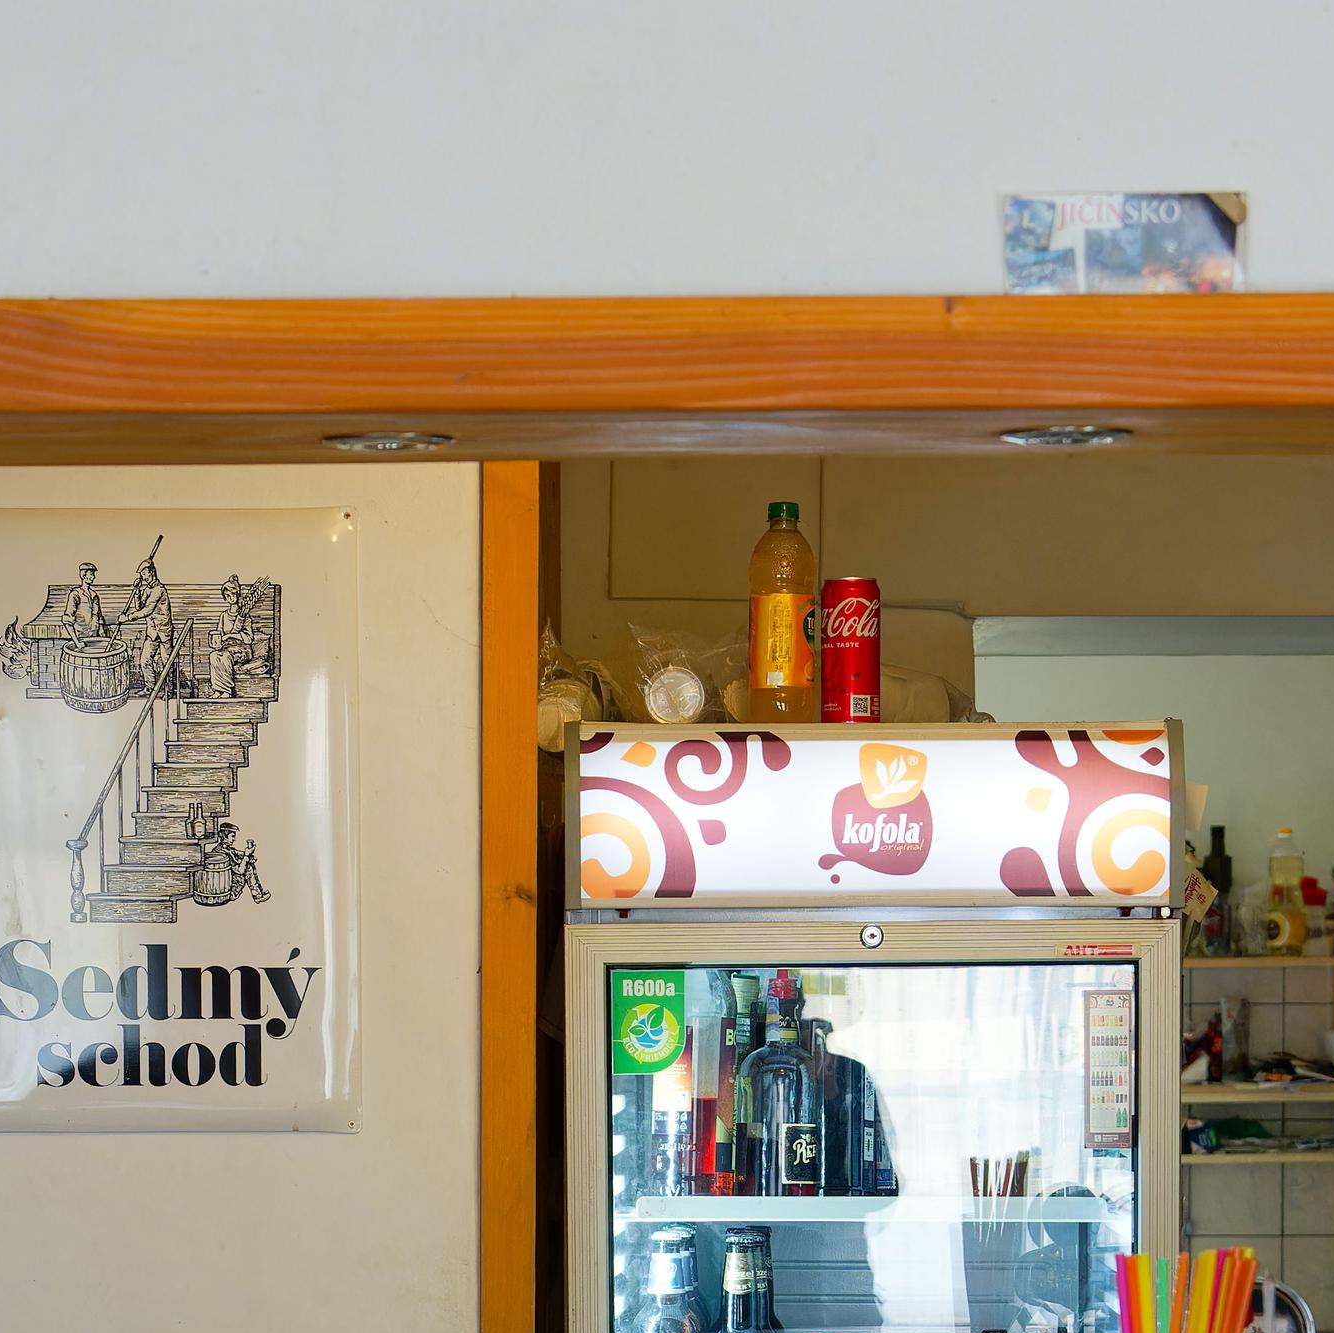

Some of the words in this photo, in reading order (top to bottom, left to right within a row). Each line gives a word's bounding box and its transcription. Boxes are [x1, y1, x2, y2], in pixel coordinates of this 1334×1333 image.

[1057, 192, 1182, 231] JIČÍNSKO
[841, 813, 923, 853] kofola
[880, 840, 925, 857] original
[622, 979, 676, 997] R600a
[36, 1024, 269, 1088] schod
